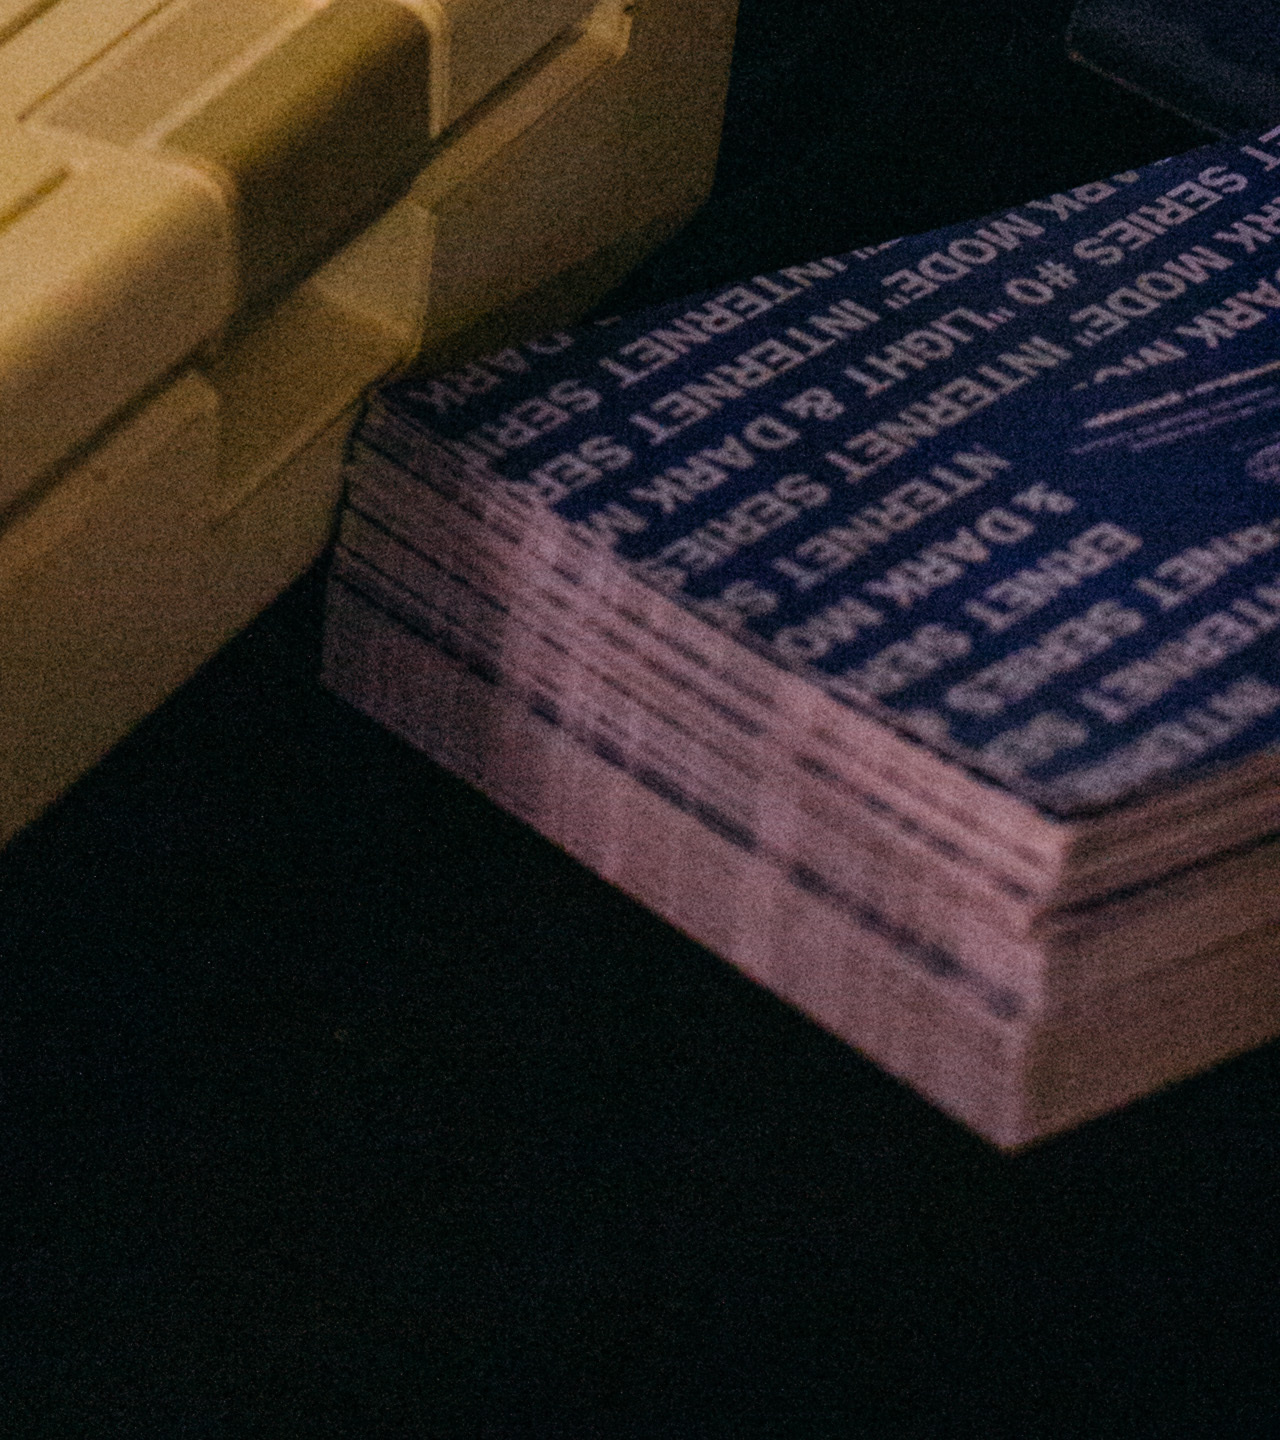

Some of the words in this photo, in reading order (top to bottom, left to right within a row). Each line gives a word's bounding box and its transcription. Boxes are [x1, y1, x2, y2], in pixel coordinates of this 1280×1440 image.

[1073, 165, 1249, 267] SERIES
[629, 297, 881, 447] INTERNET
[781, 386, 847, 422] &
[826, 334, 1073, 482] INTERNET
[628, 413, 802, 514] DARK
[867, 505, 1037, 608] DARK
